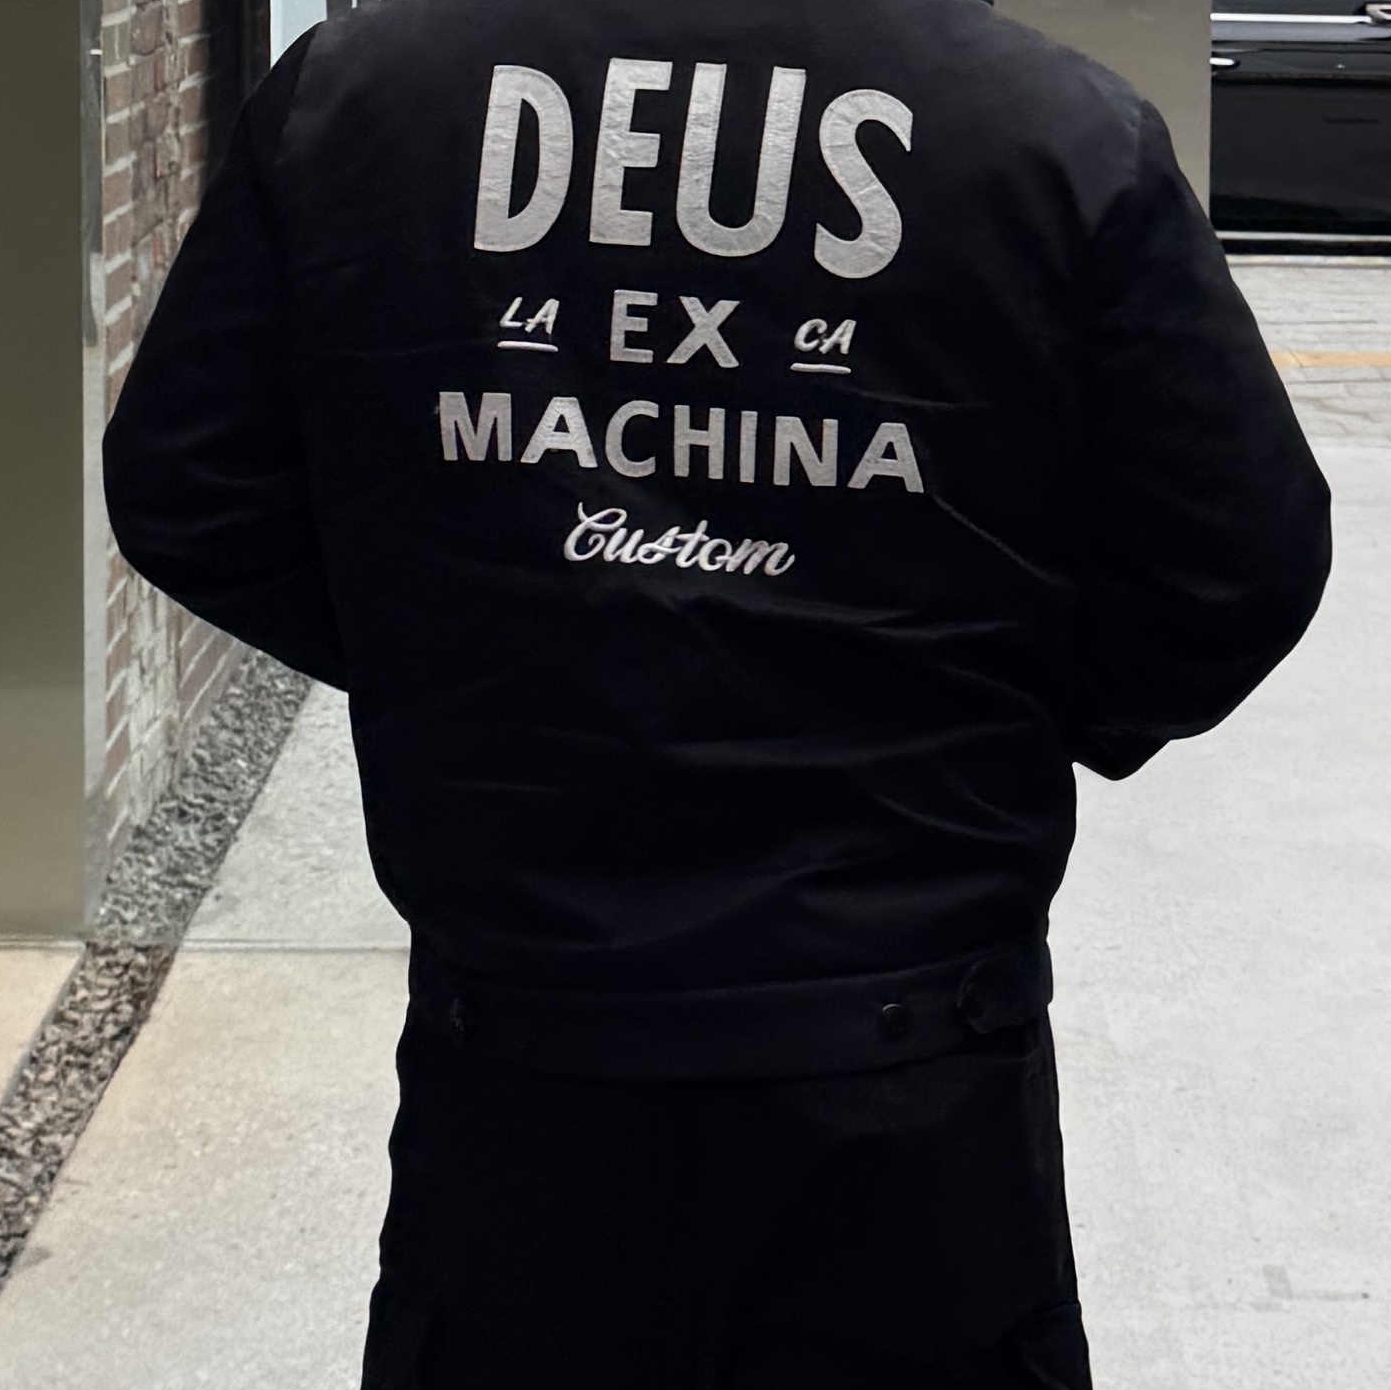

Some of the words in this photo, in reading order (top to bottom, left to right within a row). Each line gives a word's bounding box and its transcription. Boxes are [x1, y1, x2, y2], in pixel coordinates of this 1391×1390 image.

[473, 57, 914, 279] DEUS
[499, 296, 560, 336] LA
[609, 289, 741, 369] EX
[794, 318, 858, 355] CA
[438, 391, 925, 495] MACHINA
[563, 501, 796, 577] Custom
